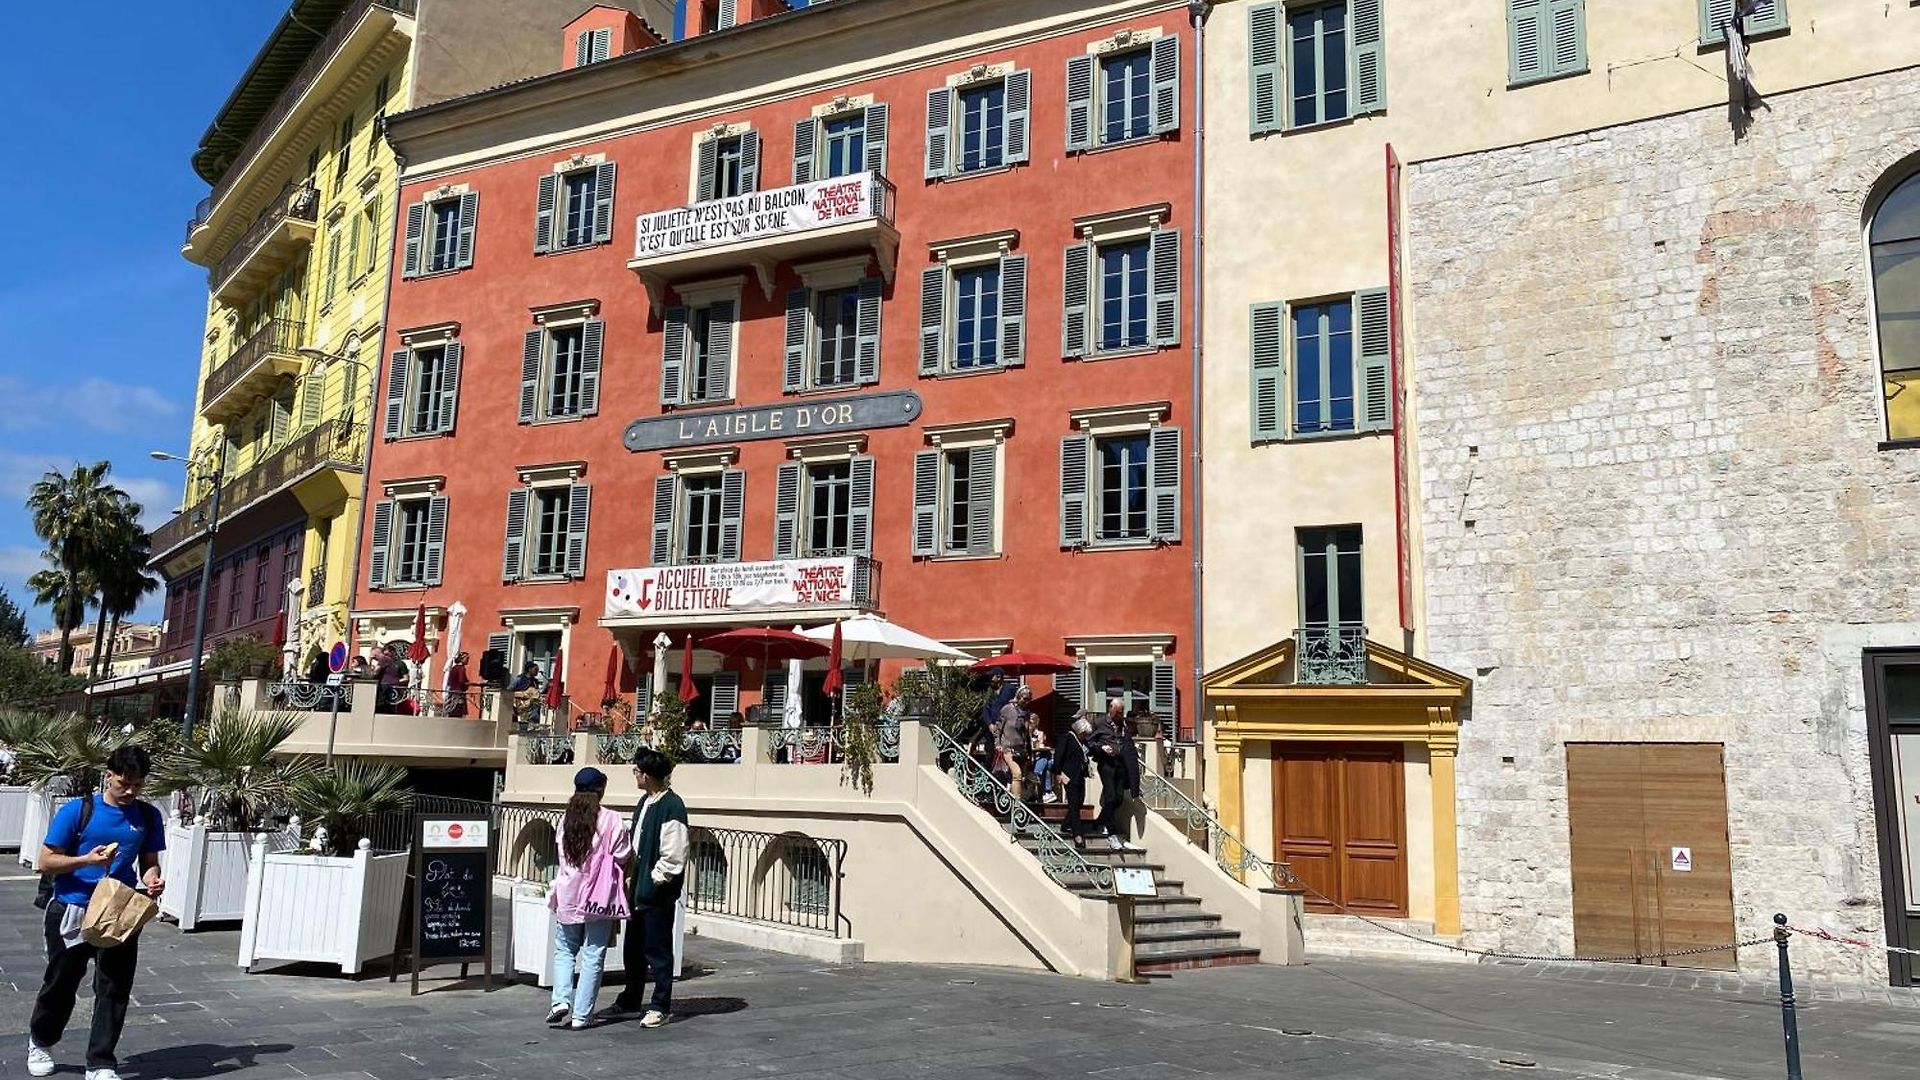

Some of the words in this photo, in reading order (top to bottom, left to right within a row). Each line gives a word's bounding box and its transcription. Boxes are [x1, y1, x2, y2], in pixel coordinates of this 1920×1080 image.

[641, 217, 650, 234] SI
[653, 209, 691, 232] JULIETTE
[695, 203, 722, 223] N'EST
[726, 200, 744, 217] PAS
[748, 196, 761, 214] AU
[765, 188, 809, 211] BALCON,
[812, 192, 865, 211] NATIONAL
[818, 209, 831, 221] DE
[834, 203, 859, 218] NICE
[640, 232, 666, 252] C'EST
[669, 225, 706, 247] QU'ELLE
[710, 221, 729, 239] EST
[731, 217, 750, 236] SUR
[679, 411, 783, 440] L'AIGLE
[796, 404, 853, 429] D'OR
[657, 567, 708, 590] ACCUEIL
[792, 578, 848, 592] NATIONAL
[654, 587, 733, 611] BILLETTERIE
[797, 591, 812, 603] DE
[813, 589, 840, 603] NICE
[584, 900, 626, 917] MoMA
